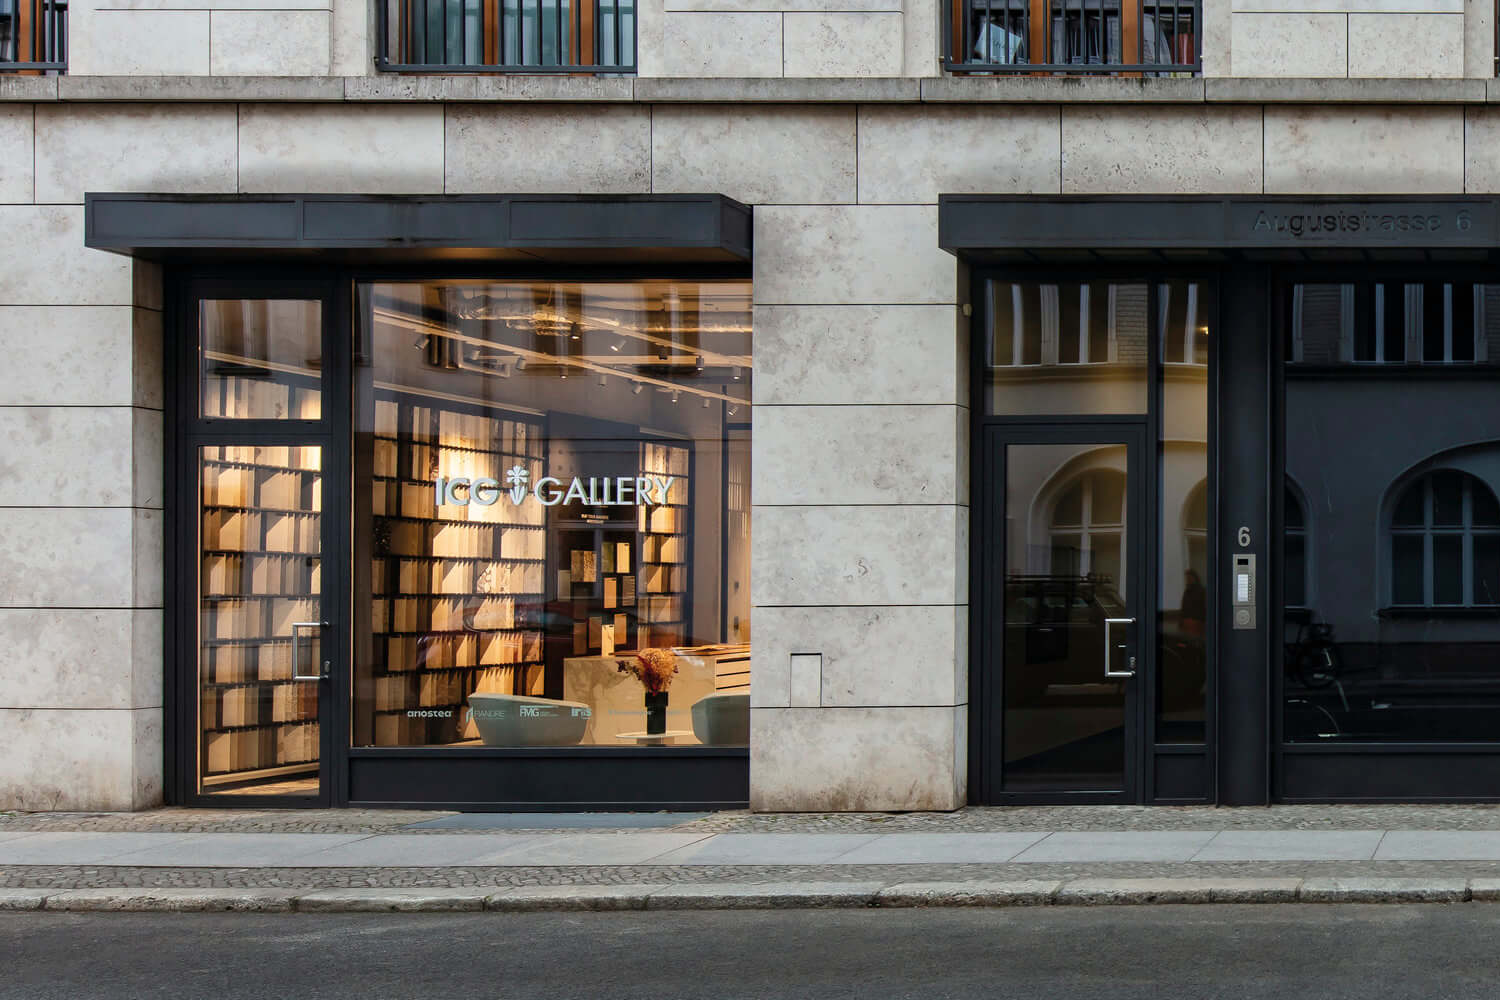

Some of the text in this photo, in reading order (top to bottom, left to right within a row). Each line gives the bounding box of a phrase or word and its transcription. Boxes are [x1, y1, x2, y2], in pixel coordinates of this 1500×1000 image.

[1253, 209, 1472, 236] Auguststrasse 6
[435, 477, 676, 506] ICG GALLERY
[1238, 526, 1251, 547] 6
